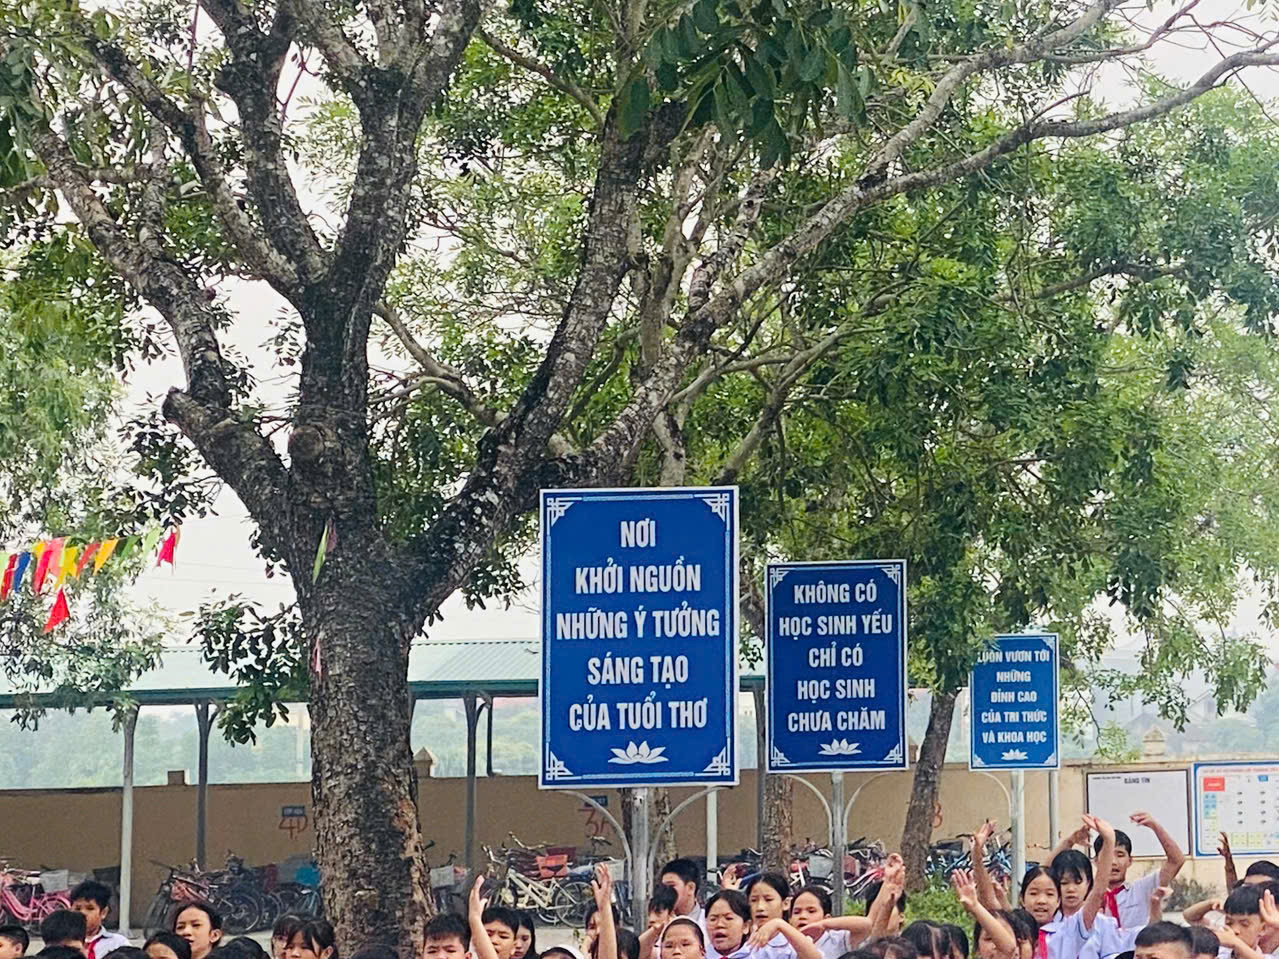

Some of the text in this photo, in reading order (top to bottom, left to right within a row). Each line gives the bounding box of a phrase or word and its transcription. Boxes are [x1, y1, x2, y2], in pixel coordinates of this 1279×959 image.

[620, 518, 656, 547] NƠI
[575, 555, 701, 594] KHỞI NGUỒN
[794, 578, 877, 604] KHÔNG CÓ
[556, 600, 720, 640] NHỮNG Ý TƯỞNG
[779, 608, 892, 640] HỌC SINH YẾU
[808, 641, 863, 668] CHỈ CÓ
[1005, 650, 1032, 662] VƯƠN
[1034, 648, 1050, 662] TỚI
[587, 652, 688, 689] SÁNG TẠO
[996, 669, 1031, 683] NHỮNG
[797, 678, 876, 704] HỌC SINH
[990, 688, 1037, 703] ĐỈNH CAO
[569, 691, 708, 731] CỦA TUỔI THƠ
[787, 706, 886, 732] CHƯA CHĂM
[981, 708, 1047, 723] CỦA TRI THỨC
[982, 729, 1047, 745] VÀ KHOA HỌC
